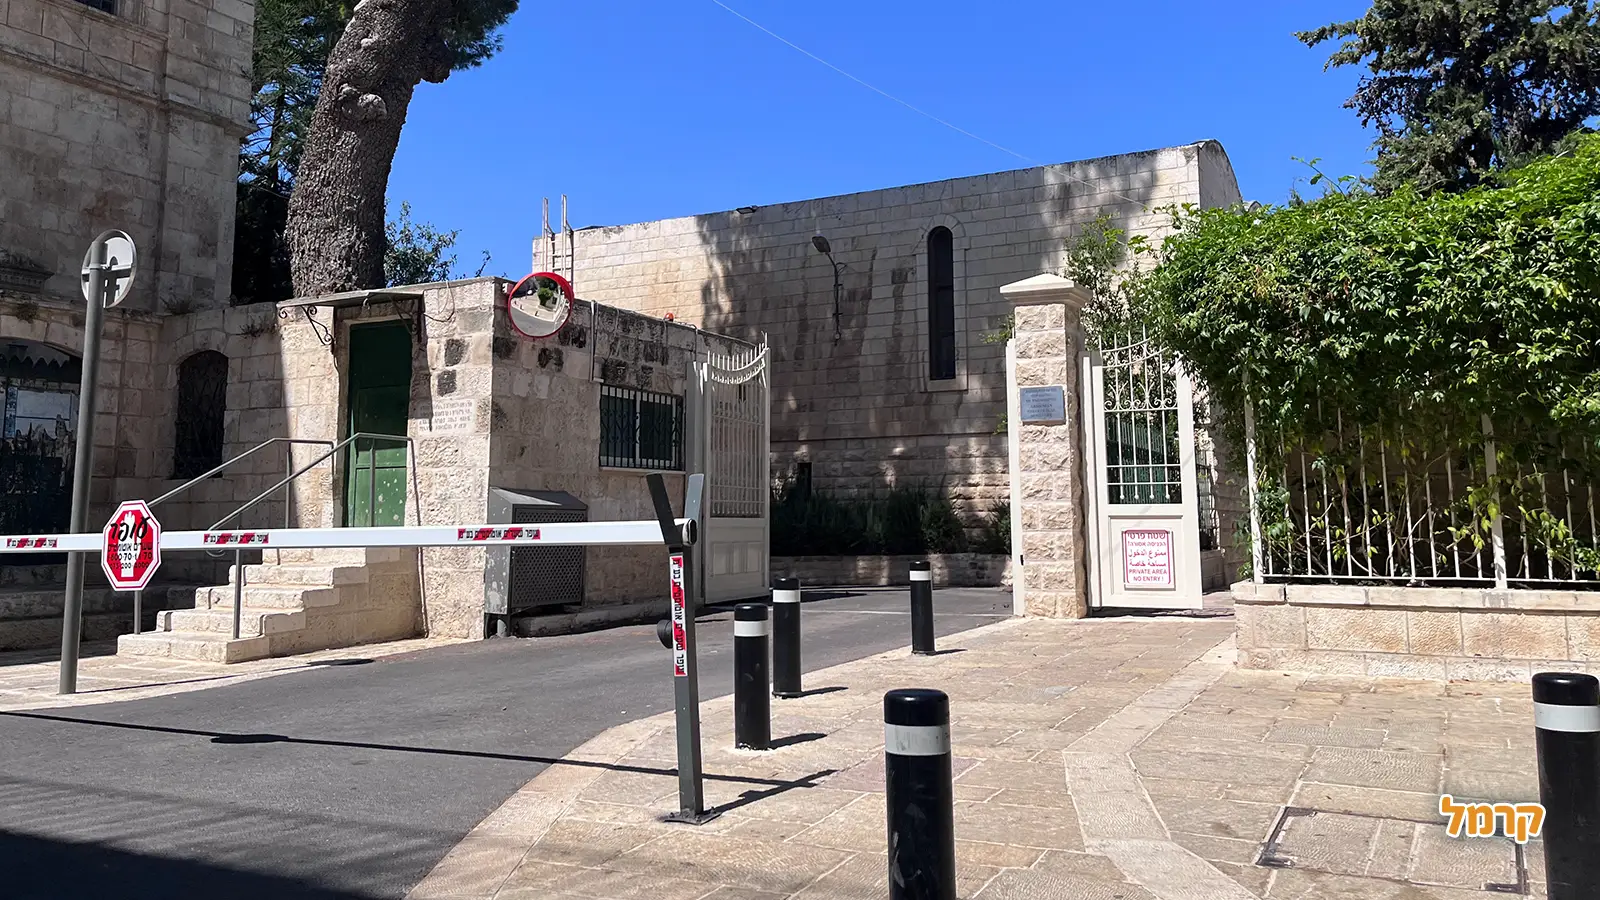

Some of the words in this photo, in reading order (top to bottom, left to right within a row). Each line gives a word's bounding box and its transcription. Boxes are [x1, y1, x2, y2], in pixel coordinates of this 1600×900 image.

[111, 516, 151, 542] עופר
[1128, 549, 1147, 558] الدخول
[1148, 549, 1167, 559] ممنوع
[1129, 559, 1146, 567] خاصة
[1147, 559, 1167, 567] مساحة
[676, 654, 684, 673] עופר
